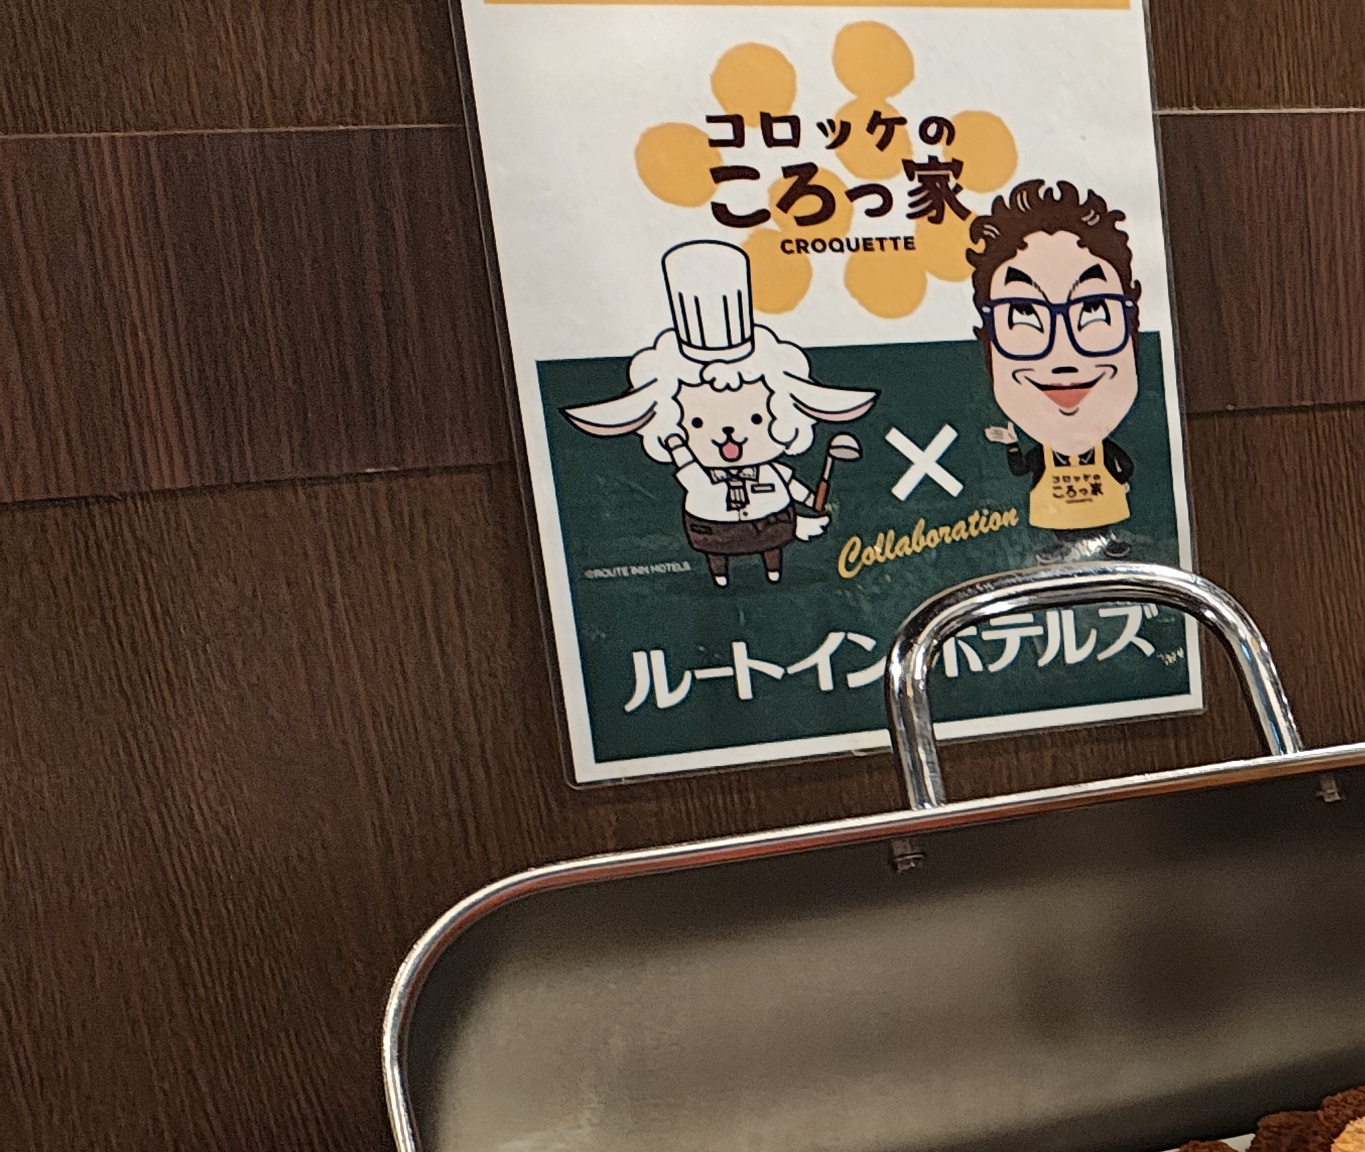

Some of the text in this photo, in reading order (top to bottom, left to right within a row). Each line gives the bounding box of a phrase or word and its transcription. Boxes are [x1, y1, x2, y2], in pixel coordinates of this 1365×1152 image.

[706, 110, 956, 152] コロッケの
[709, 155, 972, 229] ころっ家
[780, 236, 916, 255] CROQUETTE
[837, 507, 1020, 579] Collaboration
[650, 560, 692, 574] HOTELS
